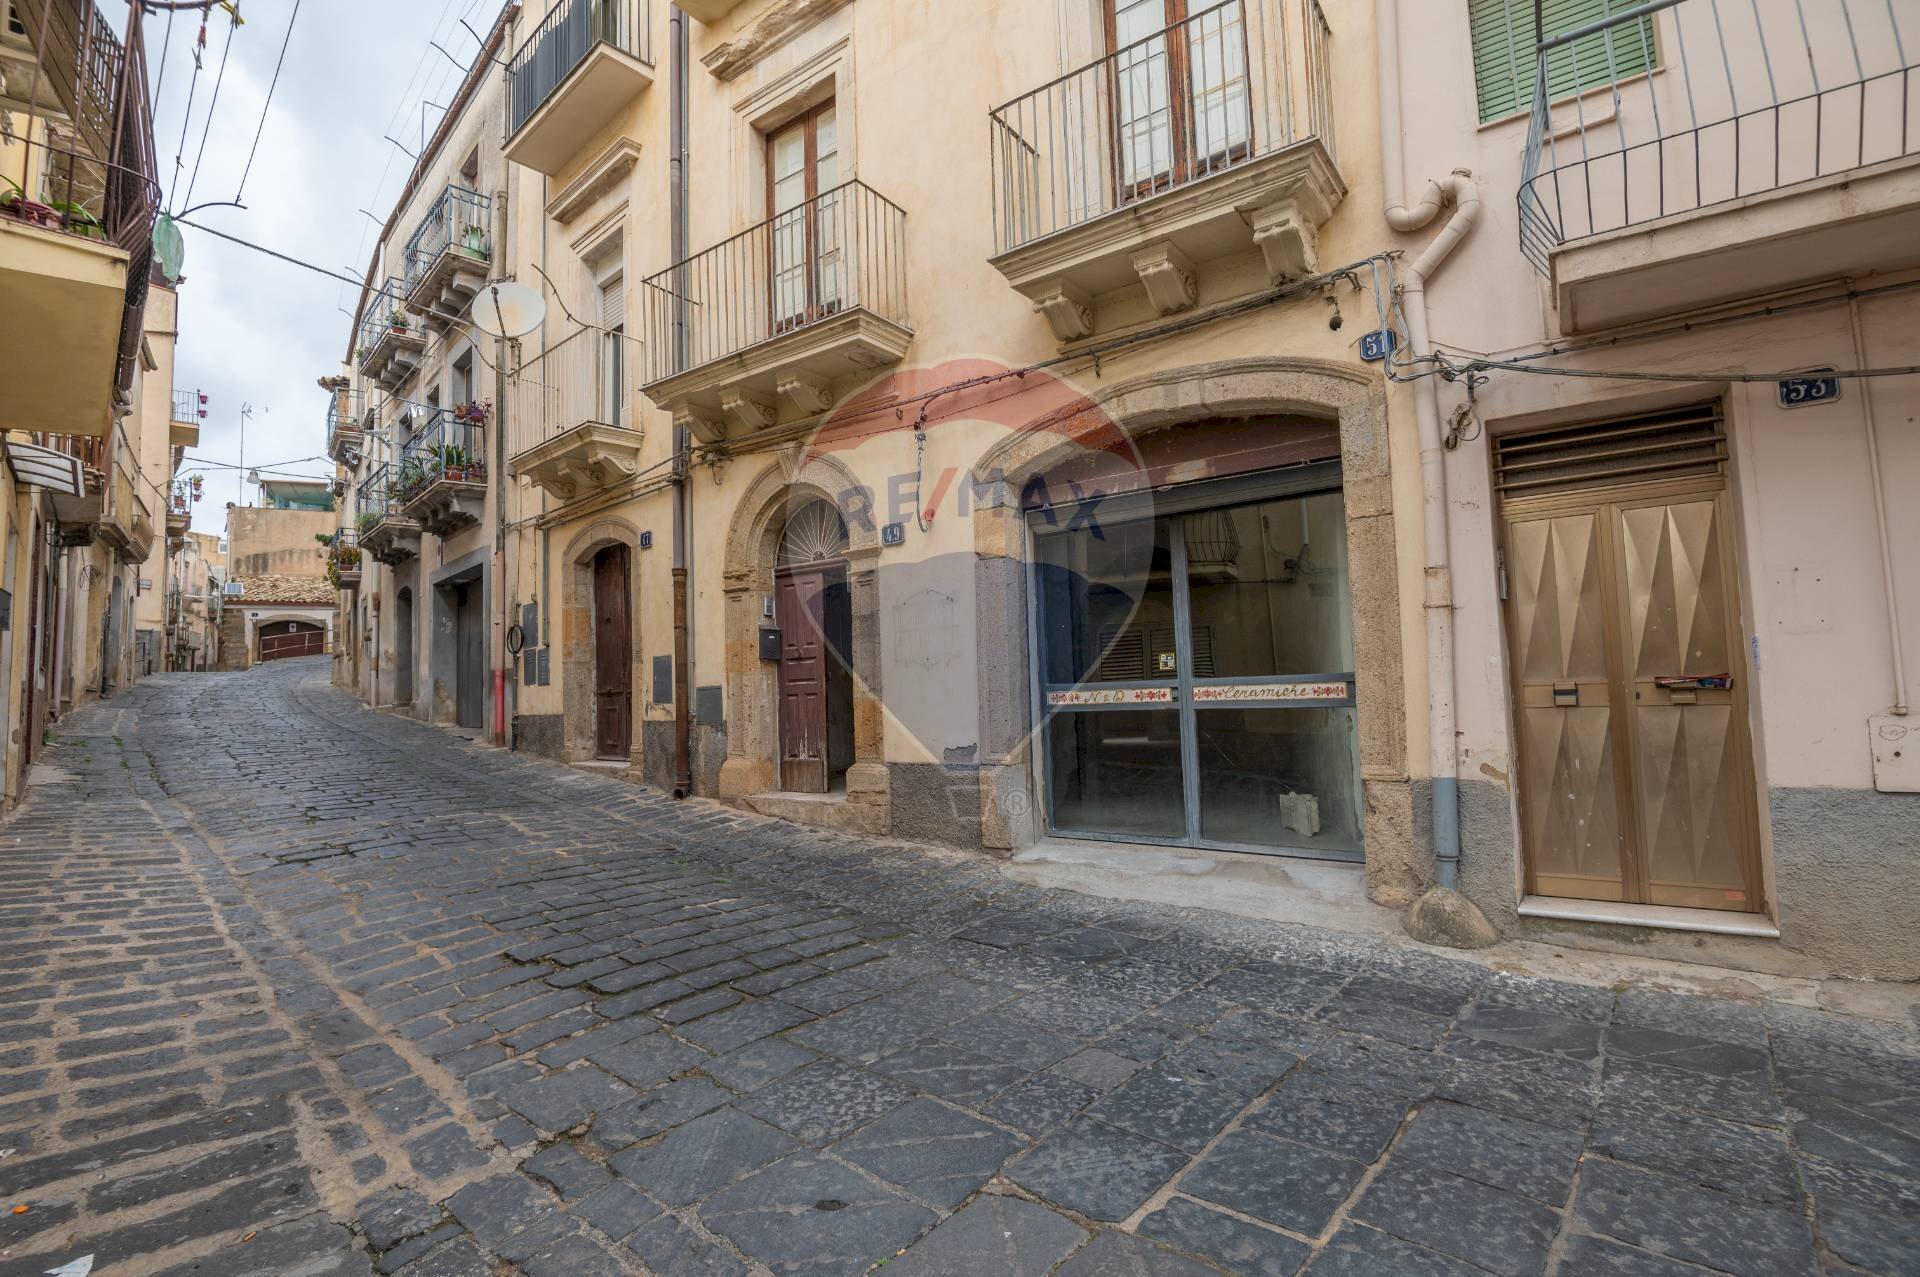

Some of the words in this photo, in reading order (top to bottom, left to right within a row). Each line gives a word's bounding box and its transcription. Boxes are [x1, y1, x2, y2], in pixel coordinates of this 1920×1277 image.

[1366, 334, 1387, 355] 51
[1789, 378, 1826, 400] 53
[886, 527, 900, 542] 49
[1222, 685, 1309, 699] Ceramiche
